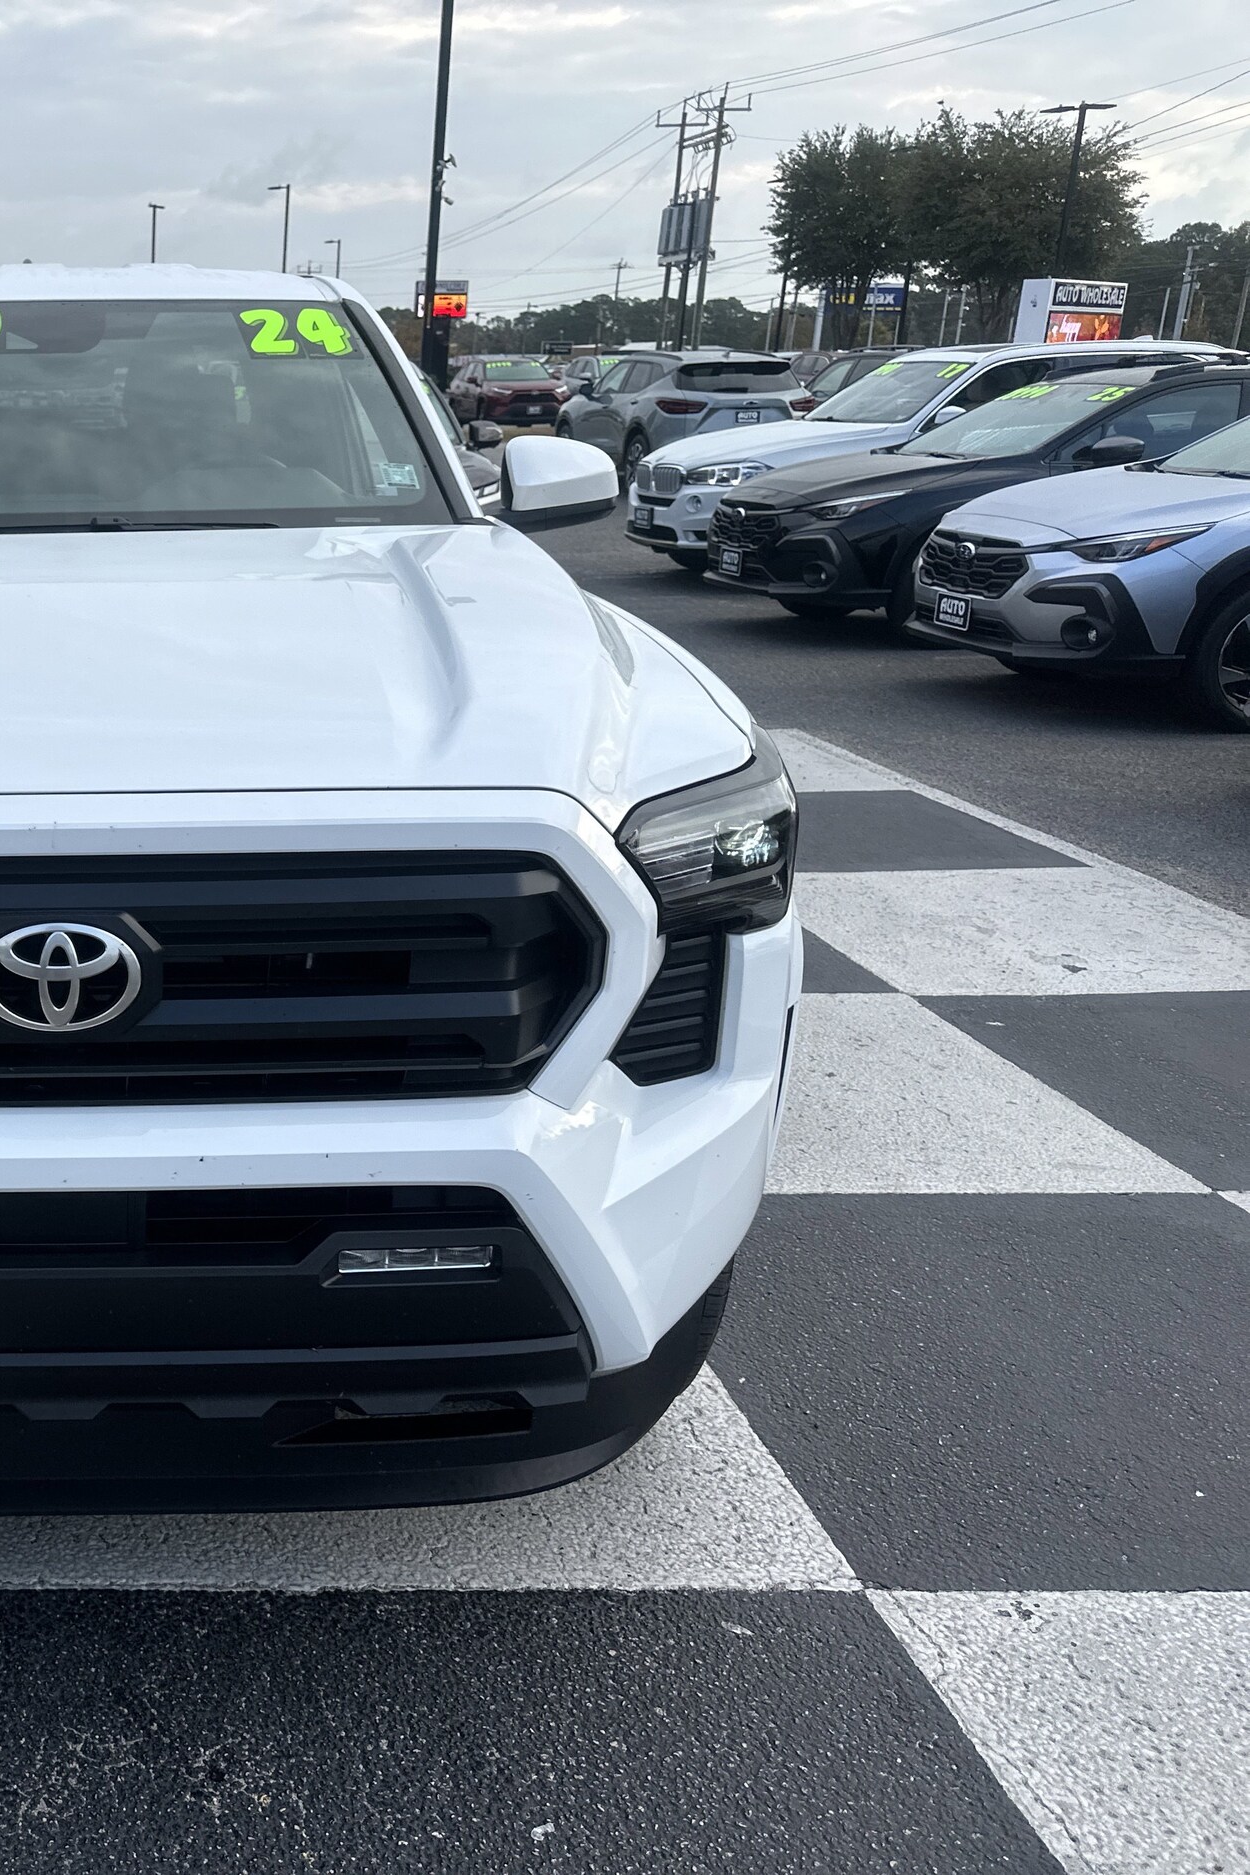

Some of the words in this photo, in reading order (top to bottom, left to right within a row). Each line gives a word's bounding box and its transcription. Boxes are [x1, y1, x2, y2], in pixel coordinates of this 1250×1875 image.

[1056, 285, 1080, 304] AUTO
[1080, 287, 1124, 306] WHOLESALE
[239, 308, 353, 356] 24
[936, 363, 970, 379] 17
[1086, 387, 1136, 401] 25
[737, 411, 758, 419] AUTO
[723, 551, 739, 565] AUTO
[940, 597, 966, 616] AUTO
